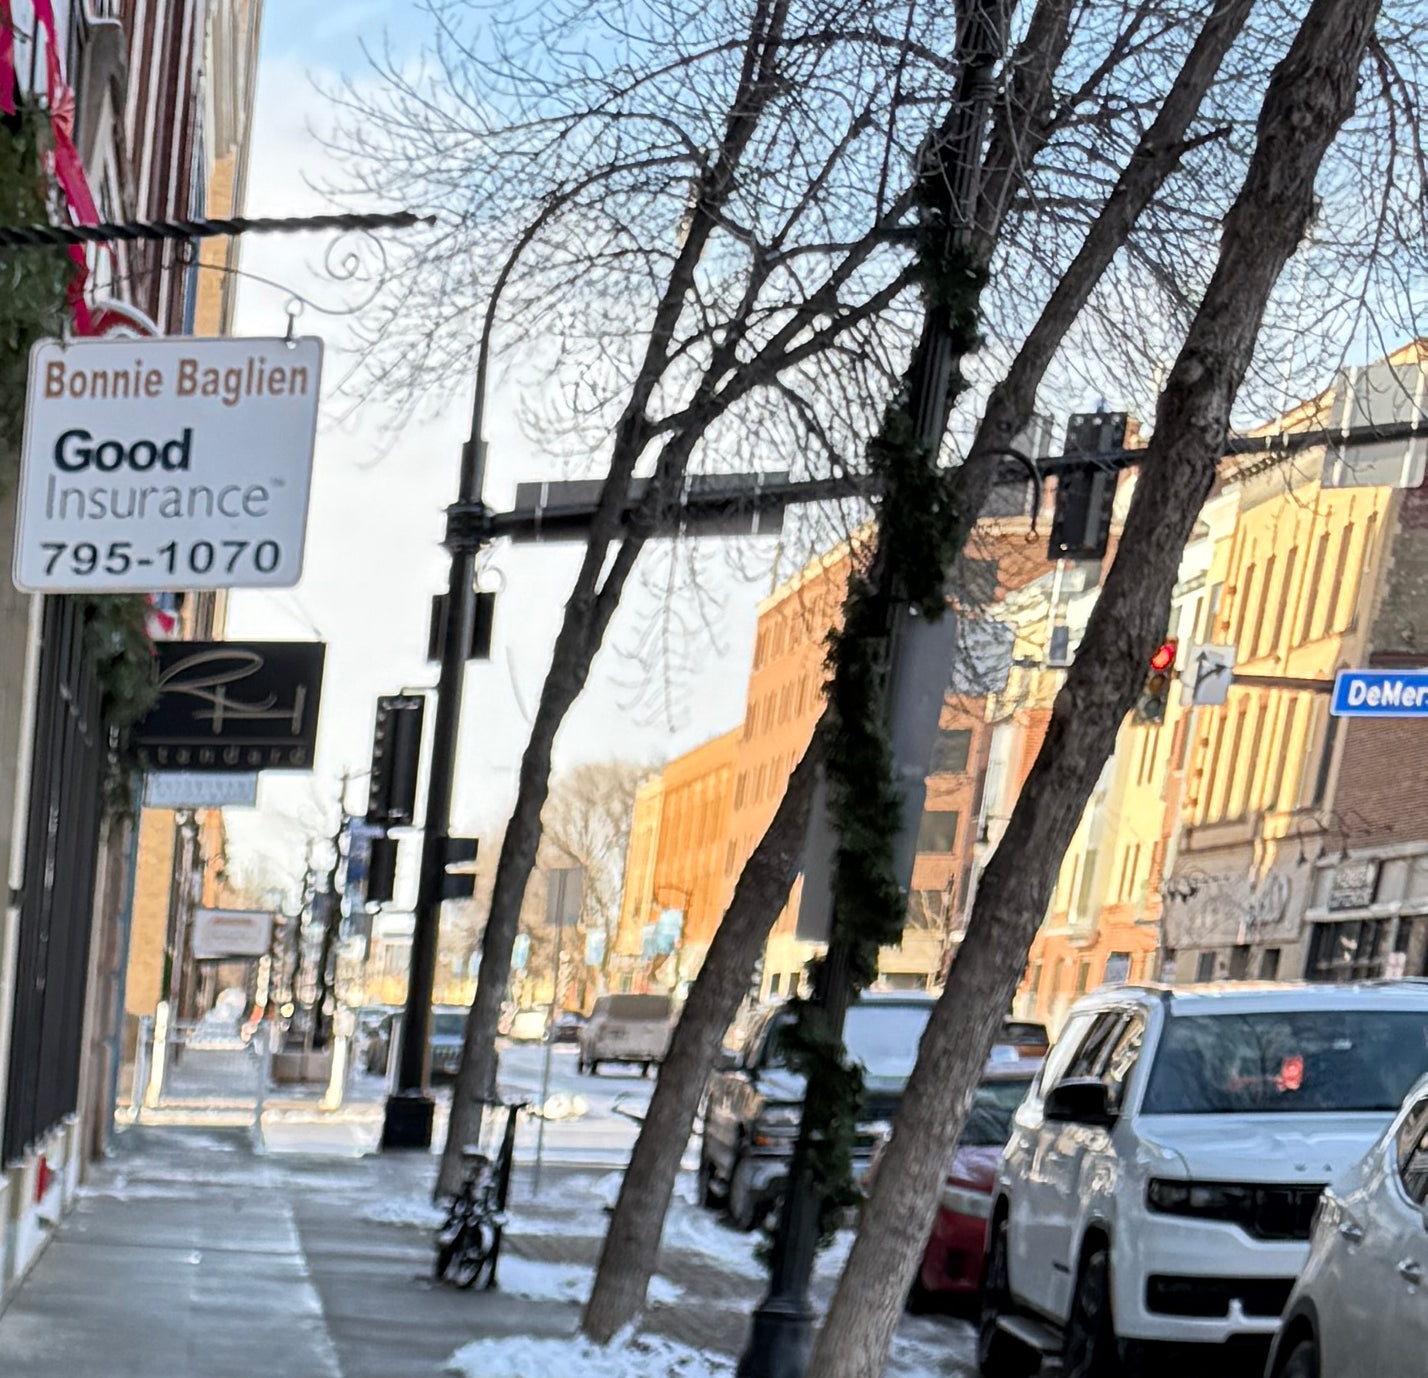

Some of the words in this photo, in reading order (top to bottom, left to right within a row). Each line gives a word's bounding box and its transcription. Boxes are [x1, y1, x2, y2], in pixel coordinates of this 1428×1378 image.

[44, 358, 163, 399] Bonnie
[176, 356, 308, 407] Baglien
[53, 427, 193, 472] Good
[41, 539, 281, 577] 795-1070
[1347, 678, 1428, 708] DeMer
